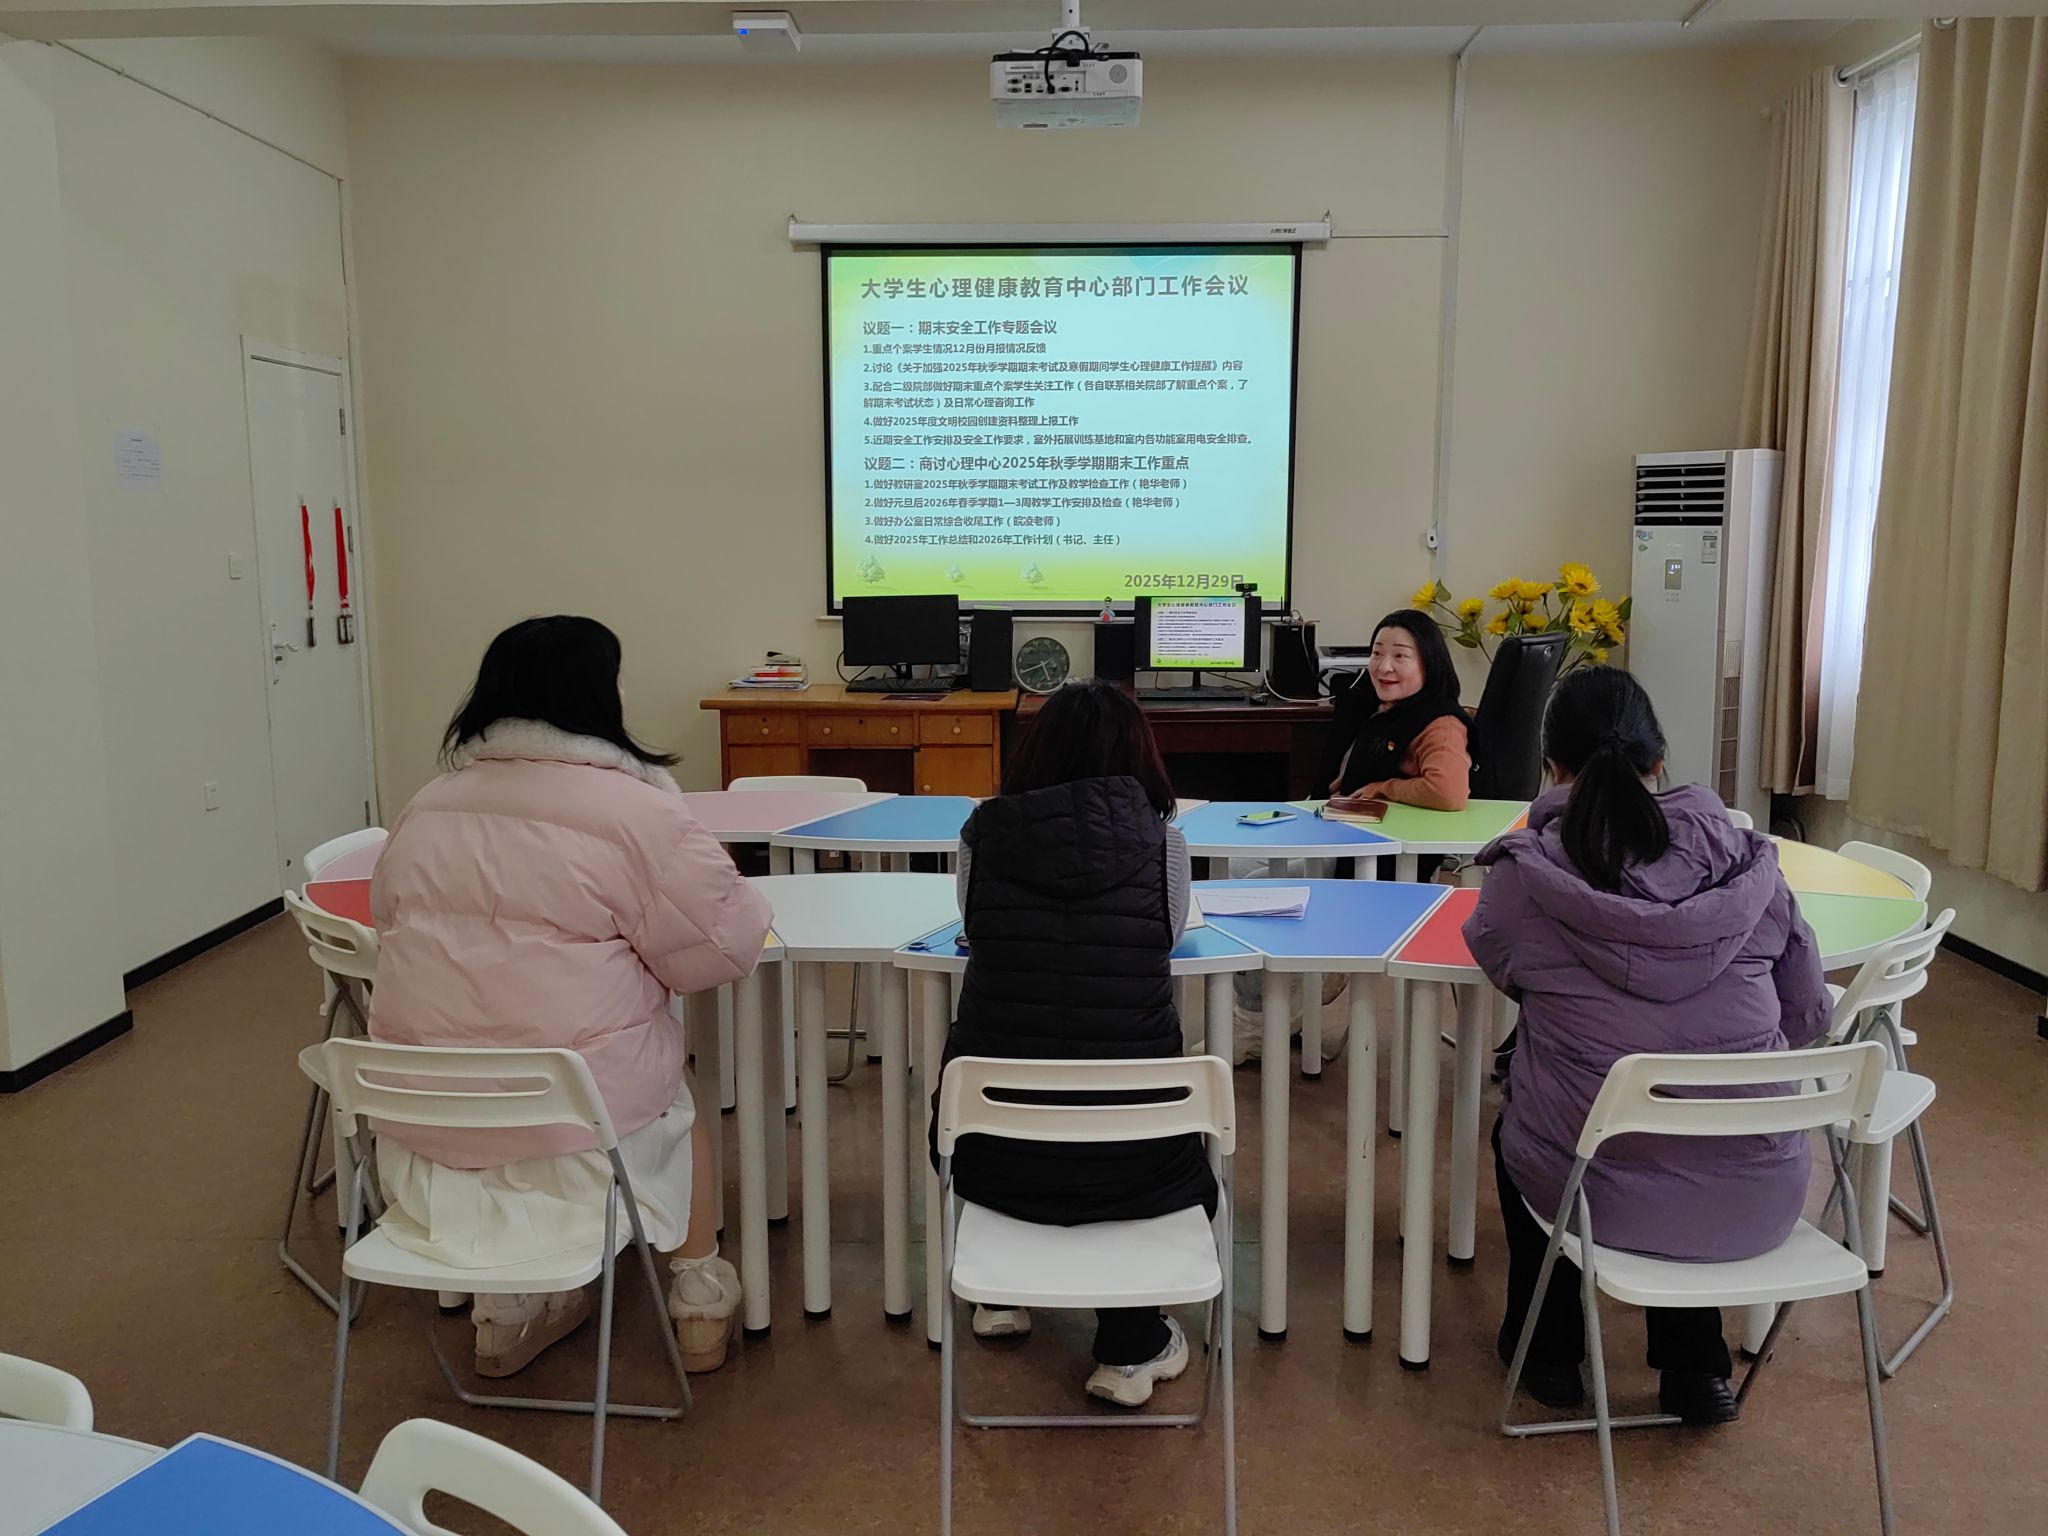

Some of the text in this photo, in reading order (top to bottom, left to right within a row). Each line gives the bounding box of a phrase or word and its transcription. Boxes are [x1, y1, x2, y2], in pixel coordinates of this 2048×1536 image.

[861, 274, 1250, 299] 大学生心理健康教育中心部门工作会议
[863, 320, 1058, 336] 议题一：期末安全工作专题会议
[863, 343, 1047, 355] 1.重点个案学生情况12月份月报情况反馈
[864, 456, 1190, 471] 议题二：商讨心理中心2025年秋季学期期末工作重点
[1124, 574, 1245, 590] 2025年12月29日
